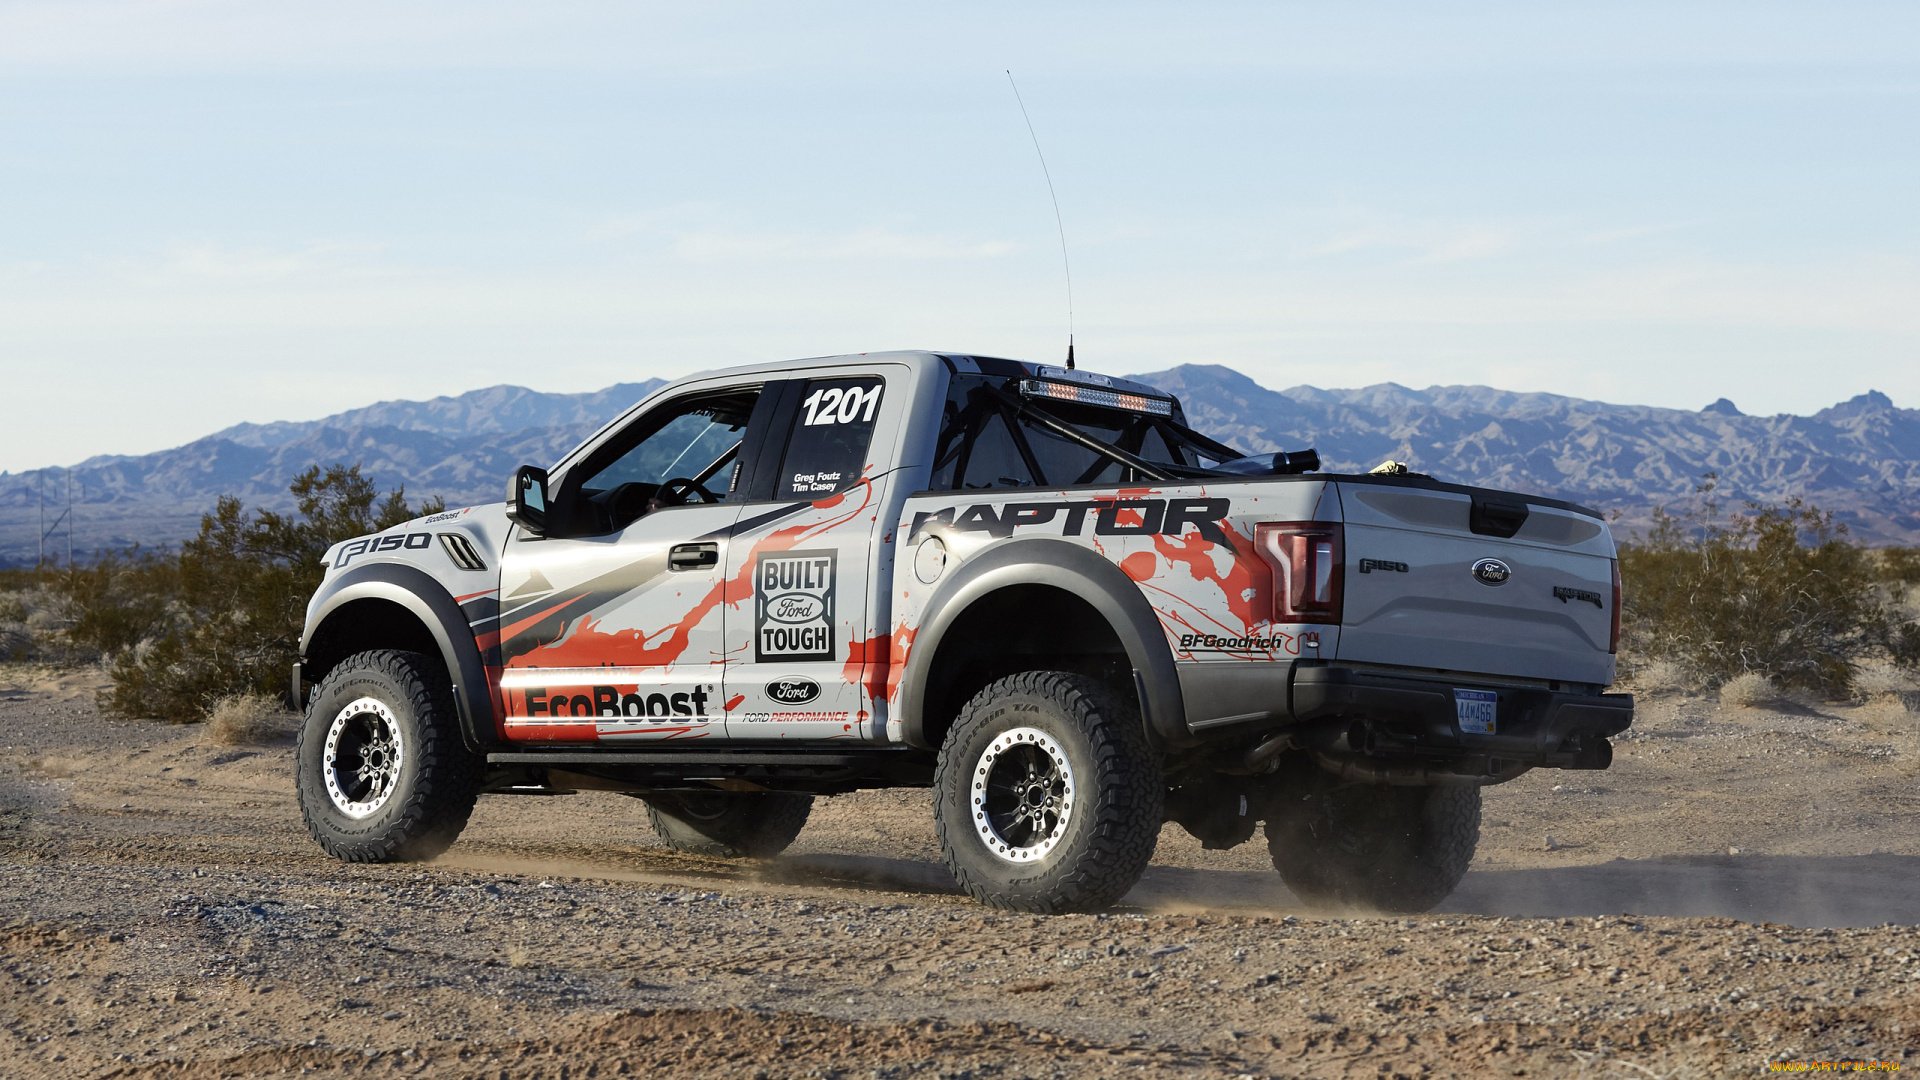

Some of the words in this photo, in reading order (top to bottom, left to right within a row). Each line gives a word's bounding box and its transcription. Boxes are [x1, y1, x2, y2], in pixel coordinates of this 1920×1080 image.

[803, 384, 882, 426] 1201
[794, 473, 814, 483] Greg
[817, 472, 841, 481] Foutz
[792, 483, 808, 492] Tim
[810, 482, 837, 492] Casey
[425, 511, 460, 524] EcoBoost
[906, 497, 1242, 557] RAPTOR
[764, 560, 829, 590] BUILT
[1482, 563, 1504, 580] Ford
[1553, 585, 1603, 609] RAPTOR
[777, 598, 813, 617] Ford
[763, 627, 826, 651] TOUGH
[1180, 634, 1282, 649] BFGoodrich
[777, 680, 809, 698] Ford
[525, 684, 709, 726] EcoBoost
[743, 712, 769, 722] FORD
[770, 711, 849, 722] PERFORMANCE
